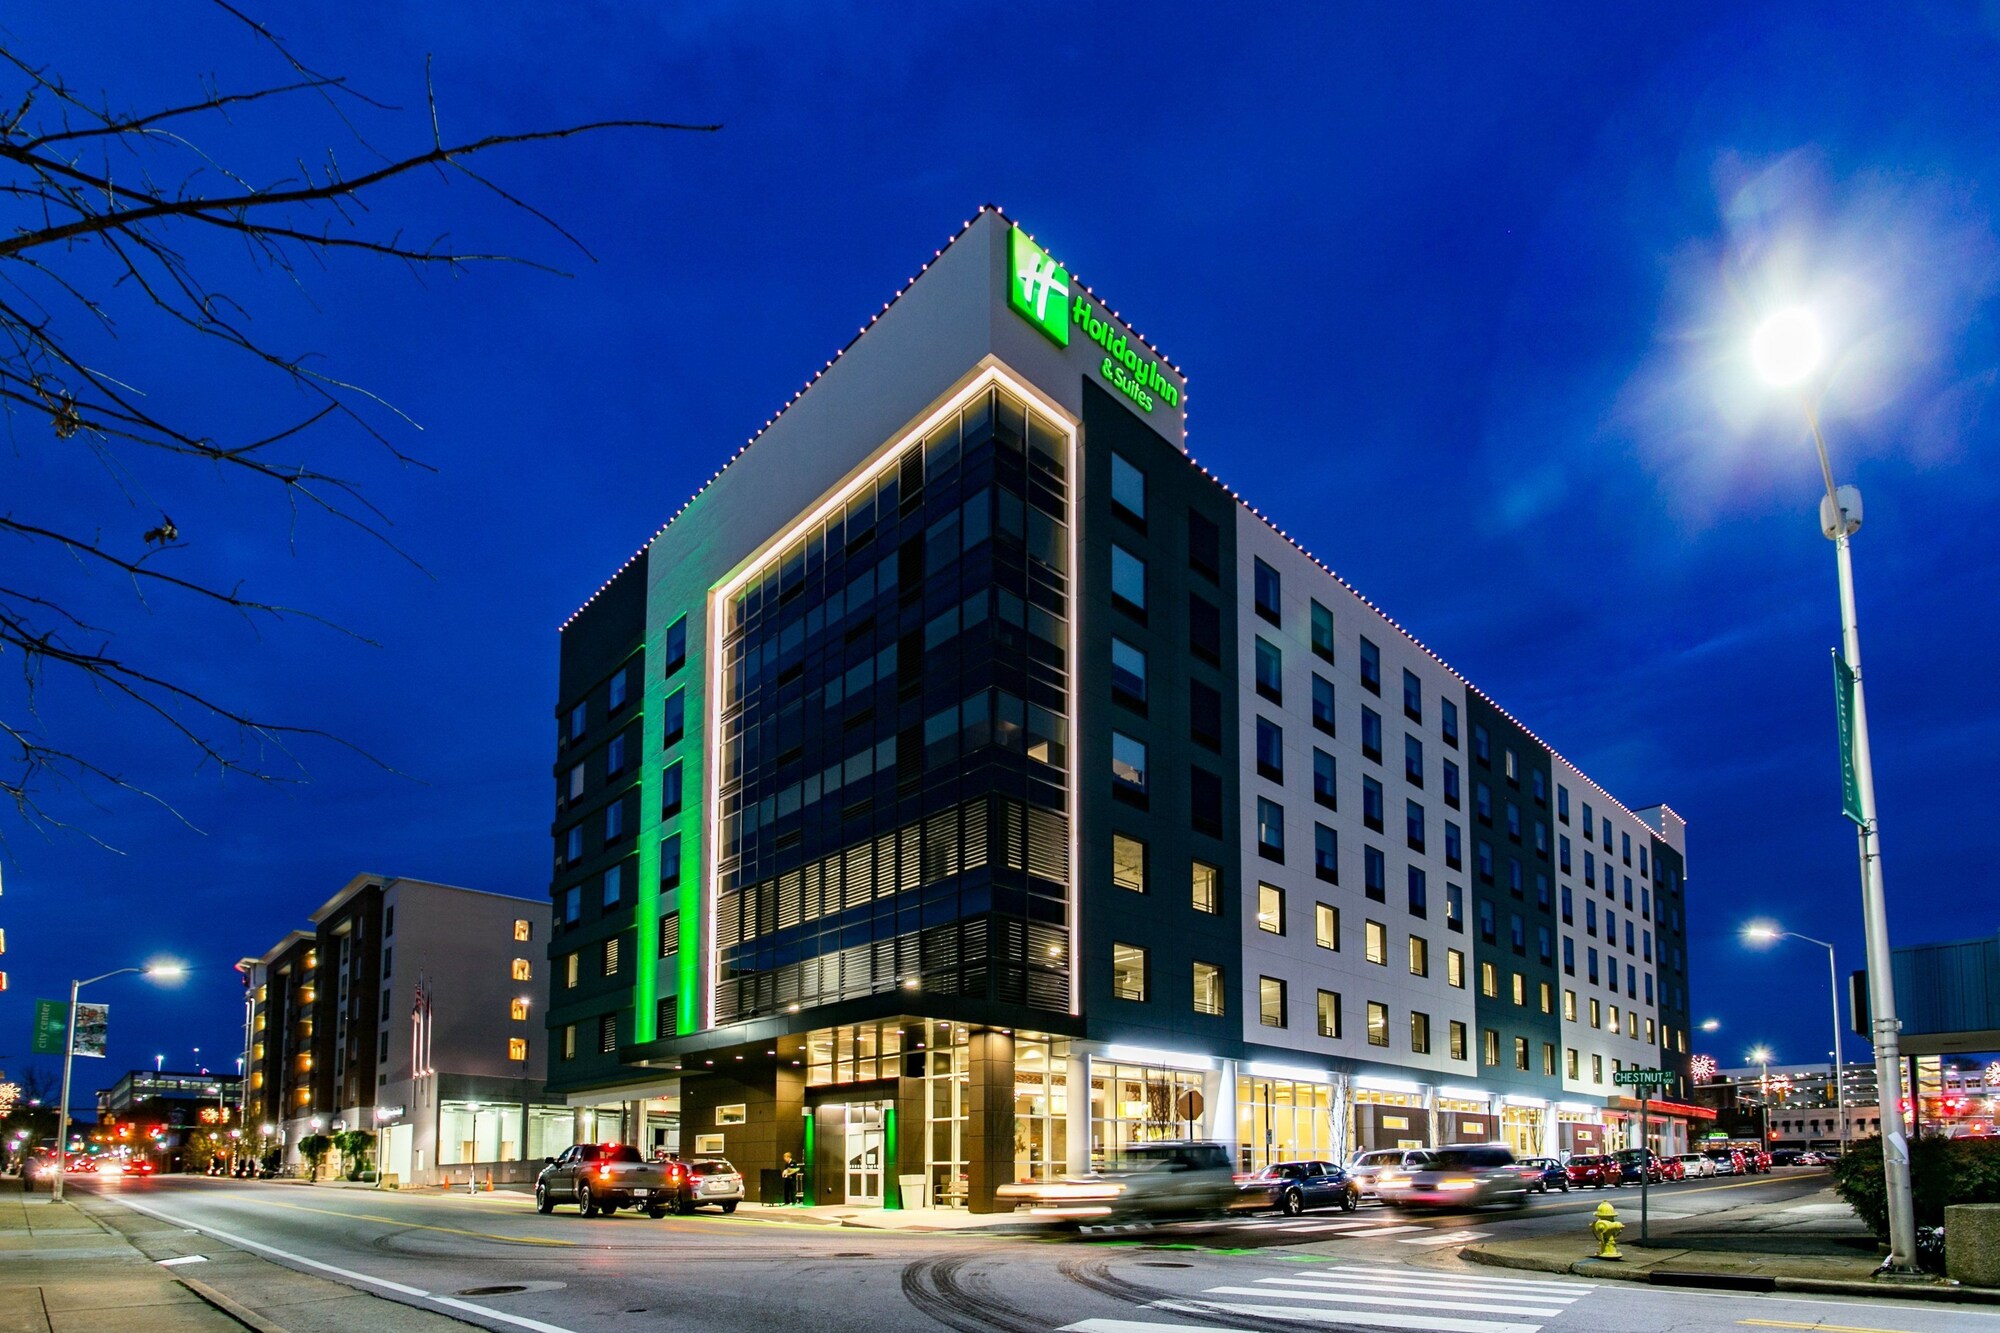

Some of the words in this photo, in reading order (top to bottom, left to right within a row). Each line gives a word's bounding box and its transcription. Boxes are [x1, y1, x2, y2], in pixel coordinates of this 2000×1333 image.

[1072, 296, 1149, 385] Holiday
[1150, 361, 1178, 407] Inn
[1101, 358, 1113, 379] &
[1114, 368, 1153, 412] Suites
[40, 1003, 50, 1030] center
[37, 1032, 49, 1048] city
[1614, 1072, 1663, 1083] CHESTNUT
